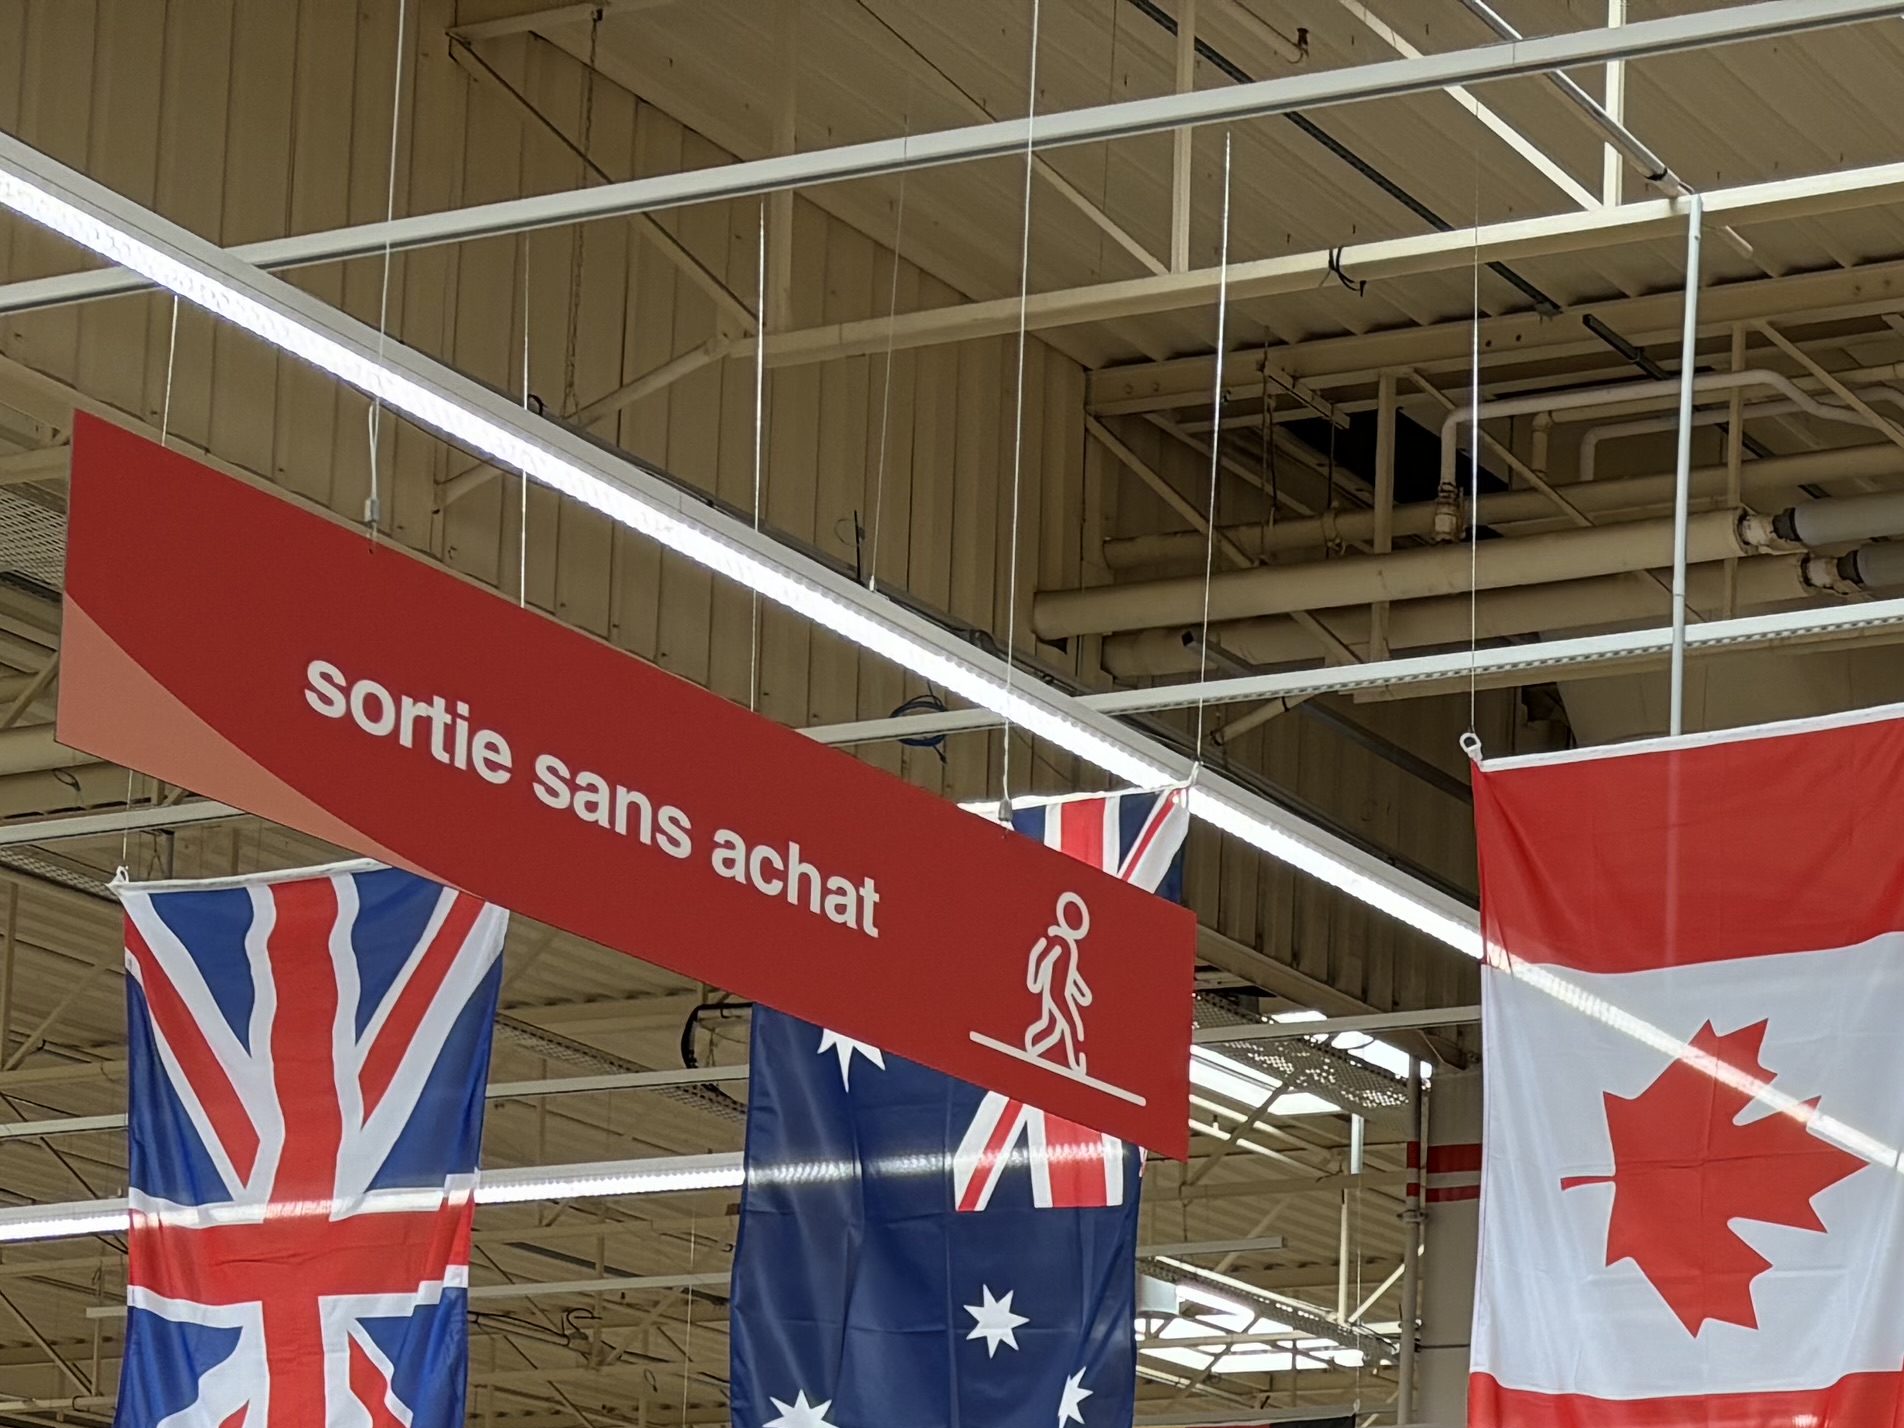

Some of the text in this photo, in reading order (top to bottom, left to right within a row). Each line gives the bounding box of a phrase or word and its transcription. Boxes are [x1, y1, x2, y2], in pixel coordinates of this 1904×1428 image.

[305, 659, 880, 937] sortie sans achat
